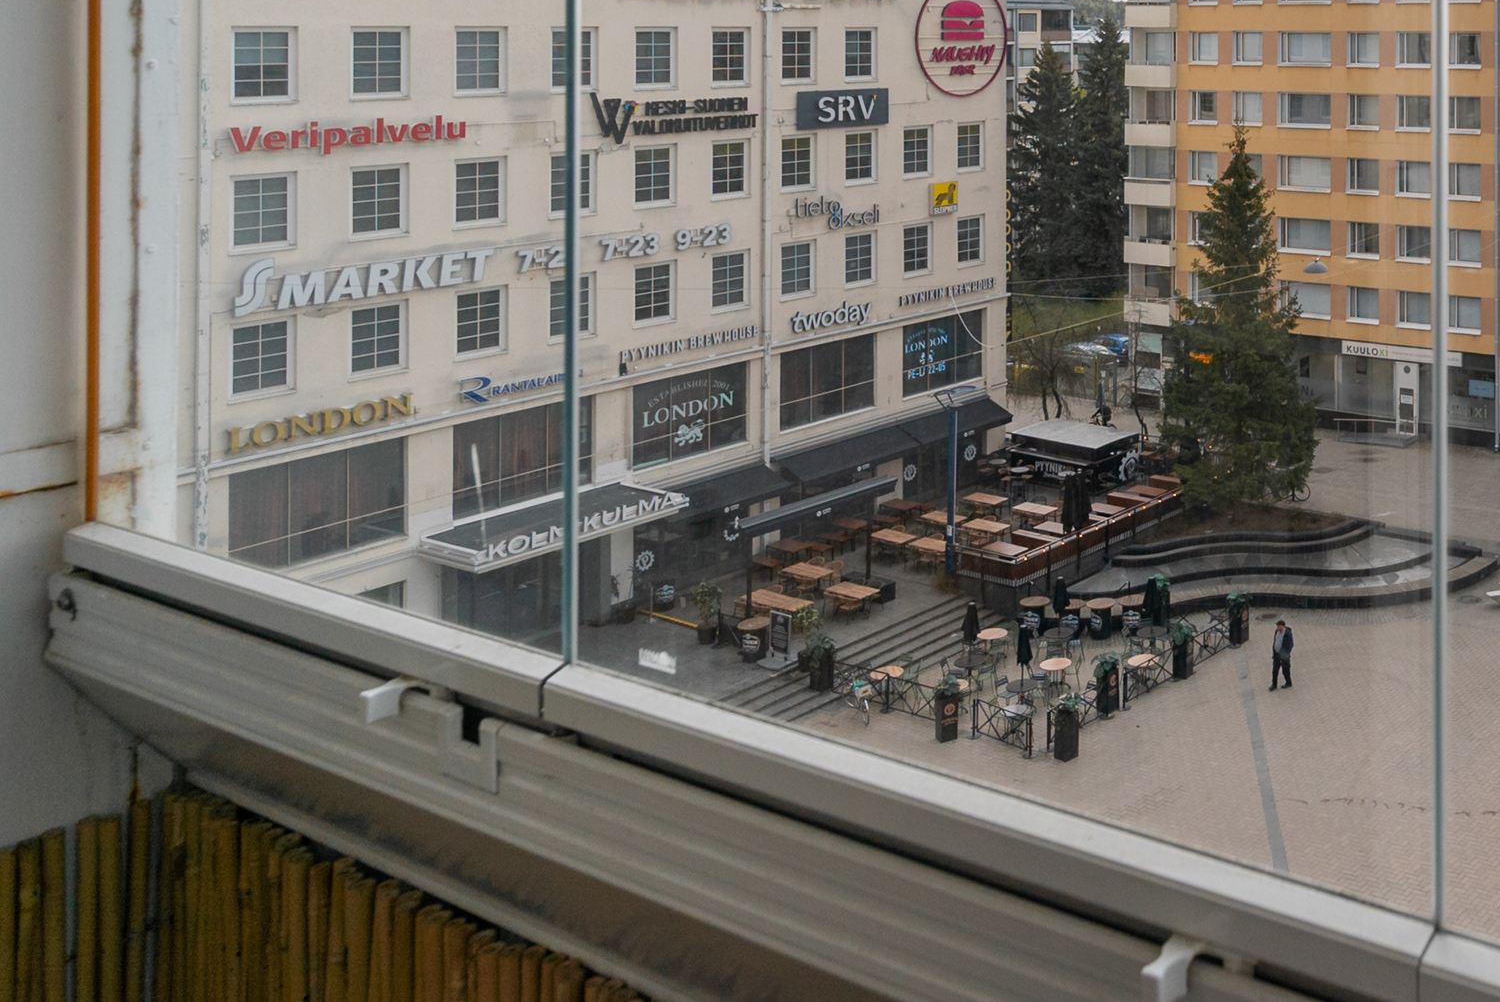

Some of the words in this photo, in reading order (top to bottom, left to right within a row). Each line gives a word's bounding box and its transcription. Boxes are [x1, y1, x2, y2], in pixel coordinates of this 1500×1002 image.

[930, 44, 996, 65] NAUGHTY
[645, 97, 748, 116] KESKI-SUOMEN
[817, 94, 877, 123] SRV
[229, 115, 467, 155] Veripalvelu
[632, 114, 759, 135] VALOKUITUVERKOT
[795, 195, 841, 218] tieto
[277, 248, 495, 310] MARKET
[518, 246, 567, 274] 7-2
[601, 233, 660, 261] 7-23
[675, 223, 732, 251] 9-23
[898, 287, 946, 306] PYYNIKIN
[946, 277, 997, 297] BREWHOUSE
[791, 300, 872, 333] twoday
[620, 339, 684, 364] PYYNIKIN
[689, 325, 760, 350] BREWHOUSE
[712, 379, 731, 392] 2001
[642, 390, 735, 428] LONDON
[227, 393, 415, 455] LONDON
